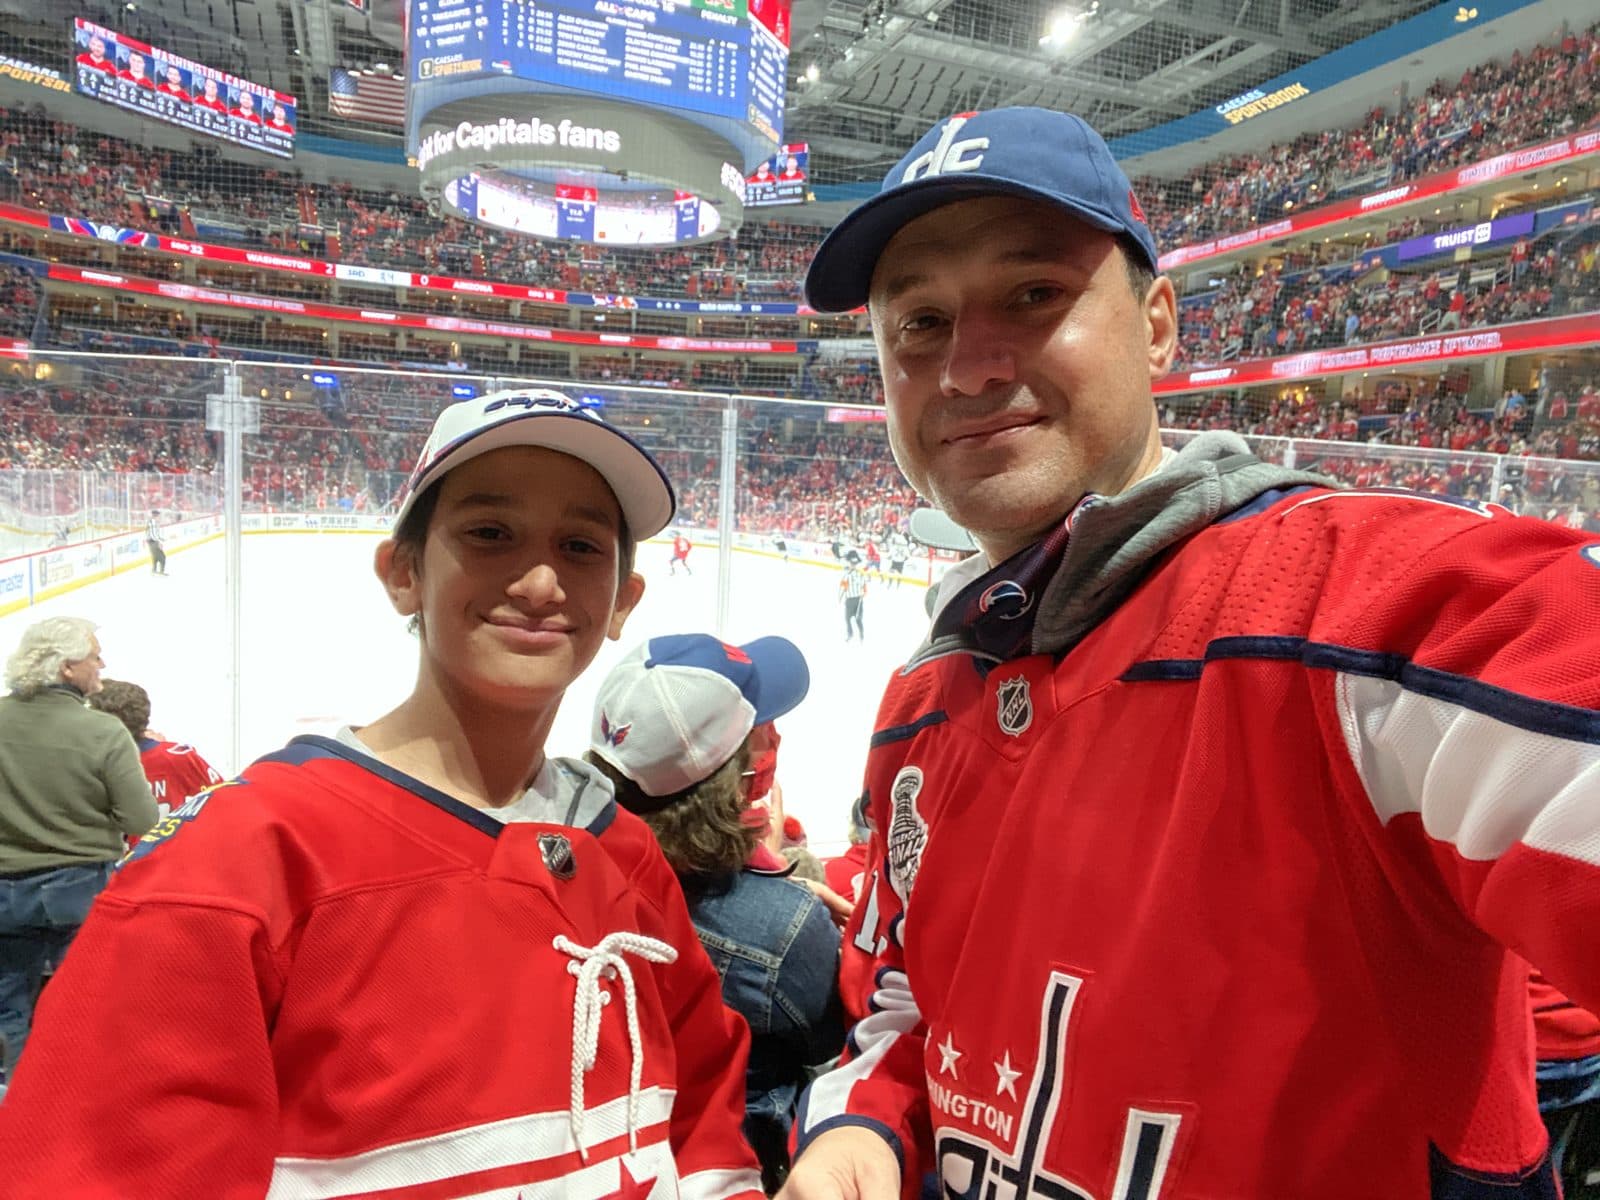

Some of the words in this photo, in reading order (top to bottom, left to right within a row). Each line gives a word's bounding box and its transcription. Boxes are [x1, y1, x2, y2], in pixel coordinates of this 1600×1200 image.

[151, 46, 223, 80] WASHINGTON
[223, 72, 276, 99] CAPITALS
[1216, 89, 1266, 114] CAESARS
[1224, 82, 1310, 124] SPORTSBOOK
[434, 130, 456, 156] for
[455, 117, 556, 151] Capitals
[558, 119, 621, 152] fans
[1434, 229, 1475, 249] TRUIST
[246, 253, 311, 271] WASHINGTON
[1006, 692, 1025, 725] NHL
